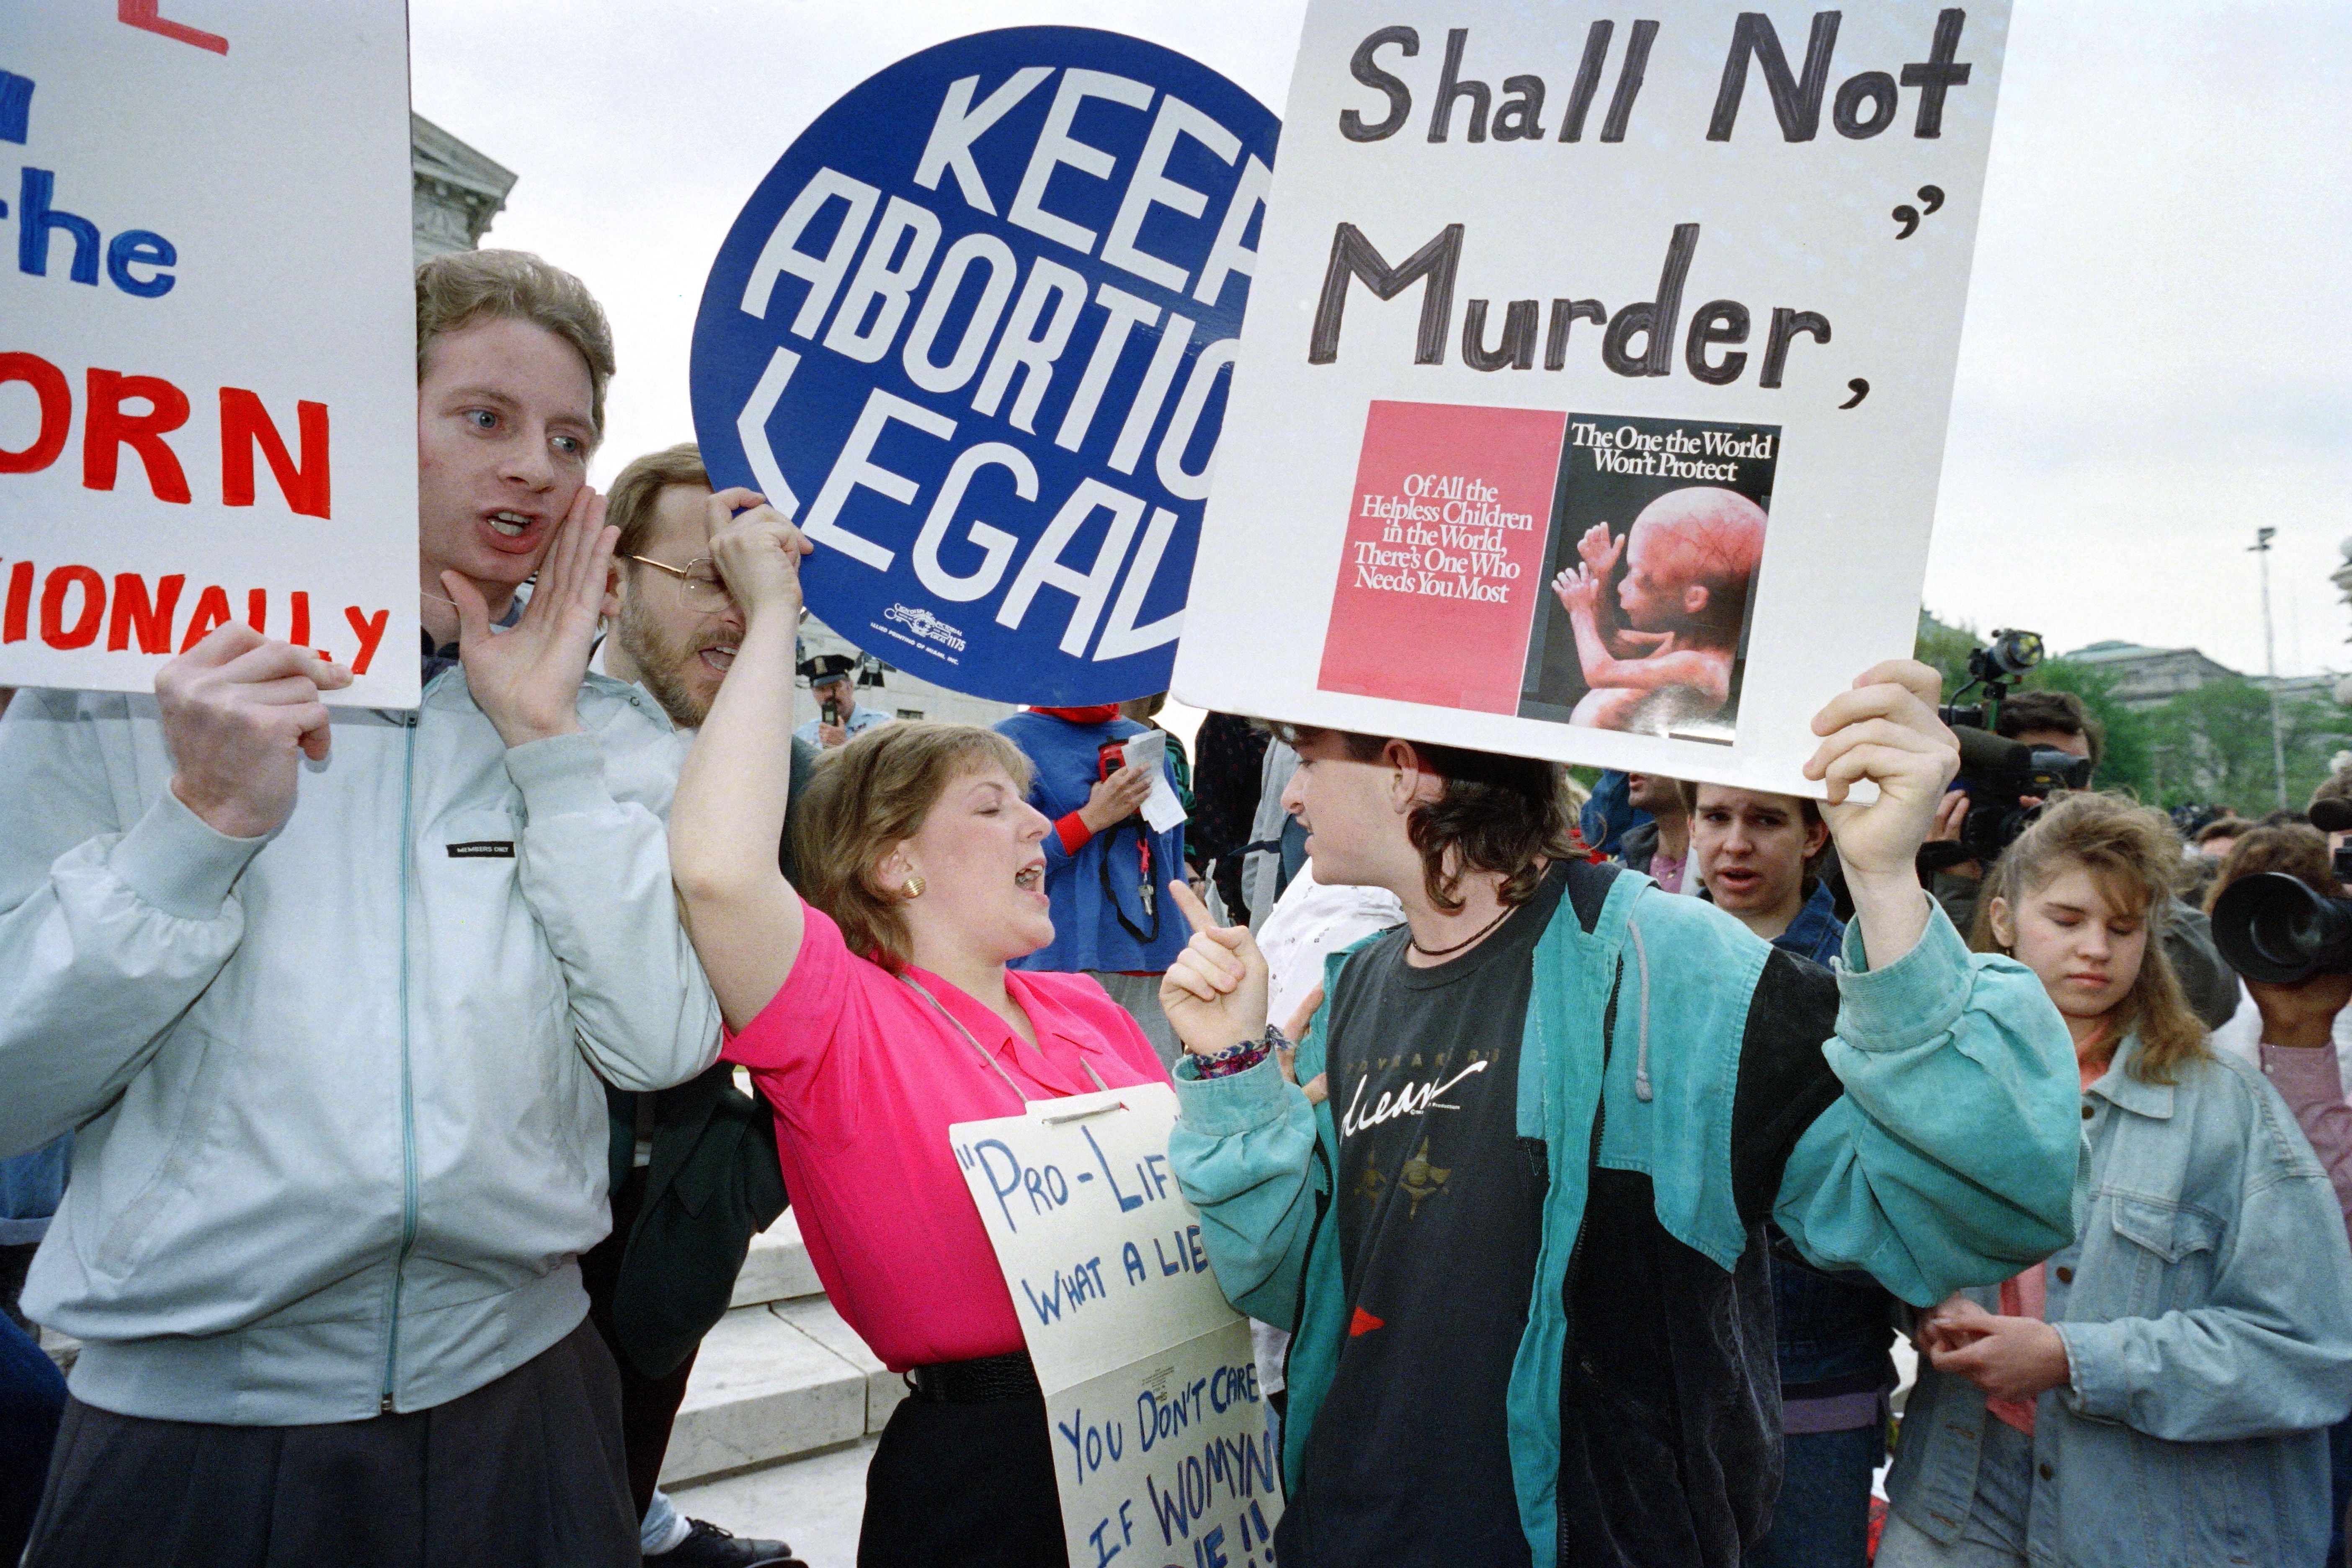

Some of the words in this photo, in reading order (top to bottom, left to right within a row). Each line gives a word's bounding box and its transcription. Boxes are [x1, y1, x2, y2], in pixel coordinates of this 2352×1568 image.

[1339, 18, 1660, 143] Shall
[1705, 8, 1972, 143] Not
[0, 167, 177, 298] he
[740, 166, 1240, 500] ABORTIO
[1571, 421, 1614, 448] The
[1615, 426, 1663, 451] One
[1666, 430, 1702, 454] the
[1702, 431, 1772, 459] World
[1593, 448, 1657, 476] Won't
[1658, 453, 1738, 482] Protect
[737, 346, 1187, 661] LEGAL
[1360, 495, 1440, 527] Helpless
[1442, 501, 1533, 531] Children
[1403, 474, 1437, 498] Of
[1434, 476, 1464, 500] All
[1466, 478, 1498, 502] the
[1354, 541, 1421, 569] There's
[1425, 548, 1469, 574] One
[1470, 552, 1520, 579] Who
[1382, 520, 1401, 543] in
[1406, 522, 1438, 546] the
[1439, 524, 1507, 556] World,
[1354, 566, 1415, 593] Needs
[1417, 571, 1454, 598] You
[1452, 582, 1509, 603] Most
[888, 630, 916, 645] PRINTING
[1021, 1256, 1107, 1325] WHAT
[1122, 1240, 1147, 1286] A
[1153, 1224, 1209, 1277] LIE
[1058, 1408, 1122, 1485] YOU
[1137, 1377, 1207, 1453] DON'T
[1210, 1362, 1260, 1413] CARE
[1089, 1499, 1133, 1568] IF
[1146, 1430, 1275, 1546] WOMYN
[1162, 1499, 1274, 1568] IE!!
